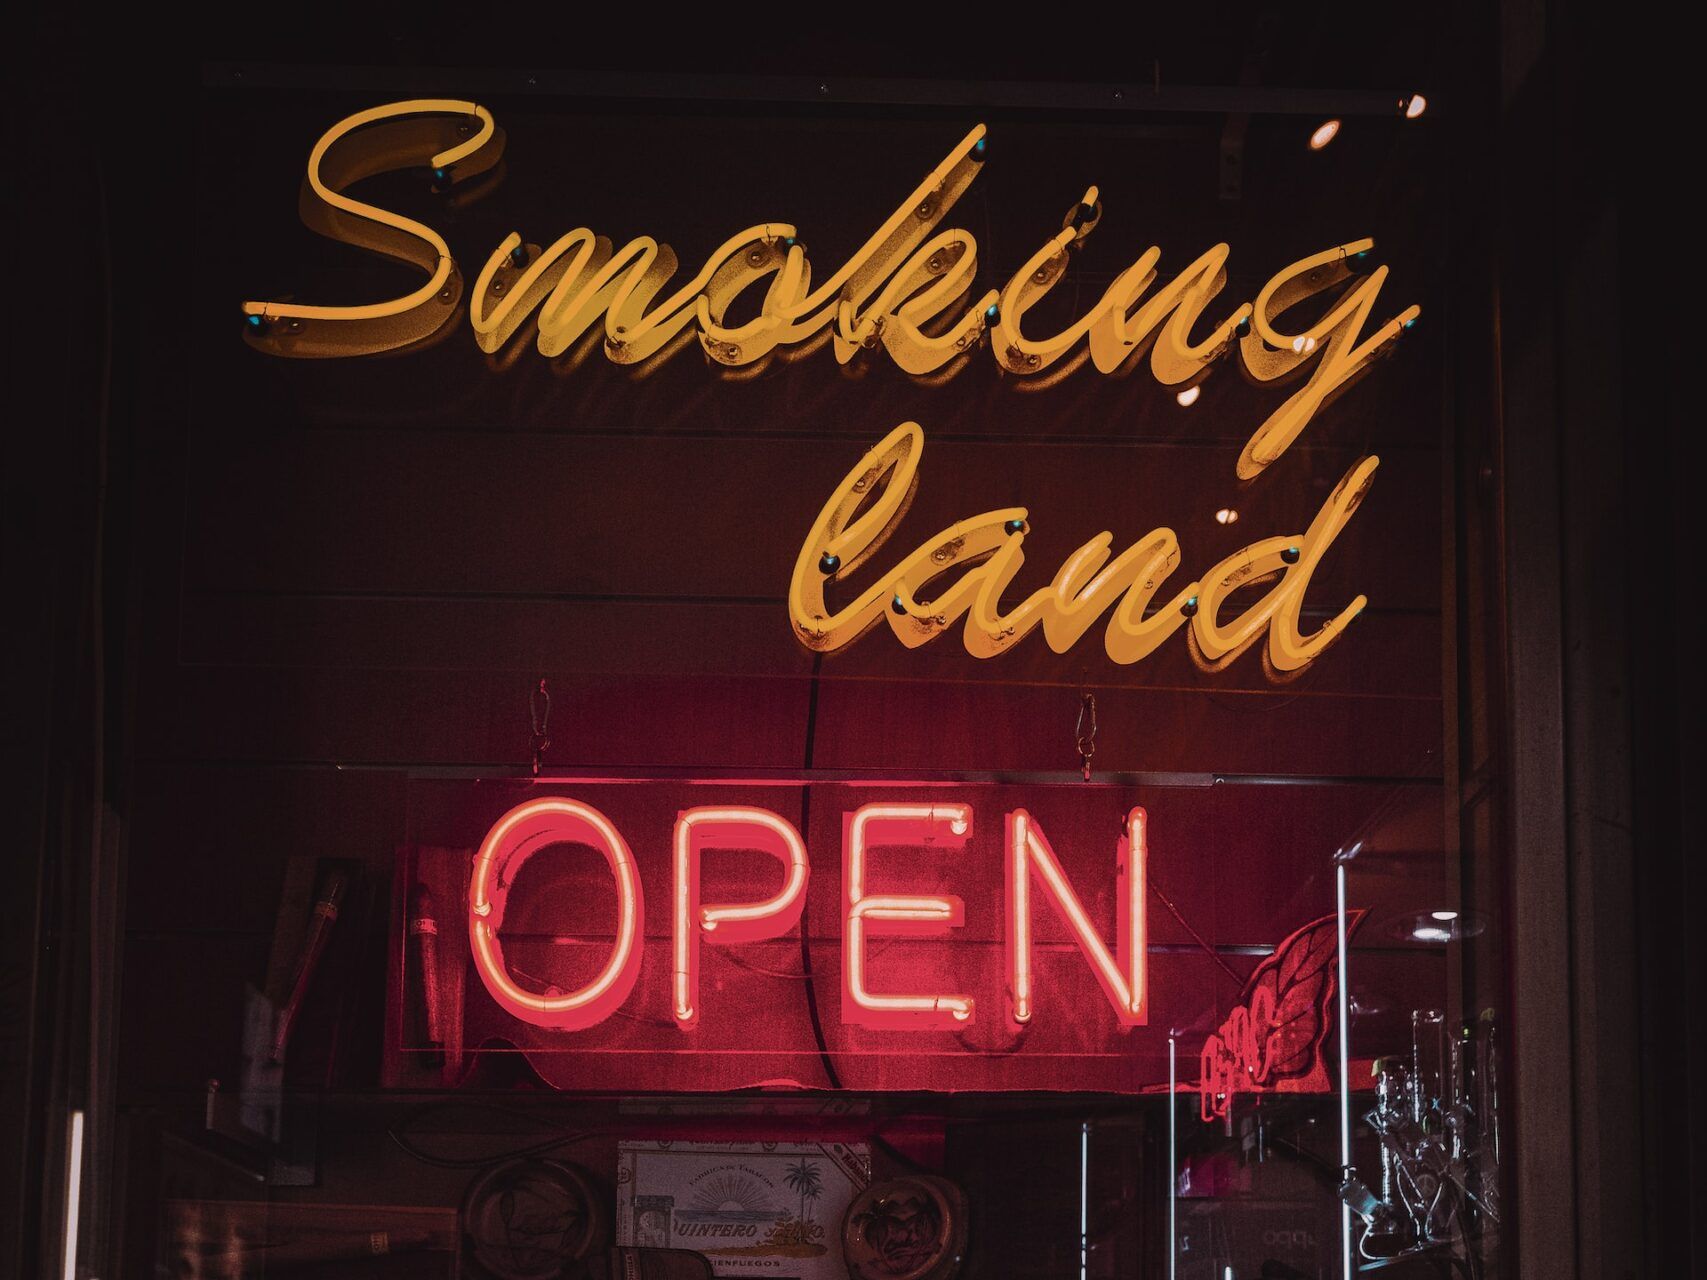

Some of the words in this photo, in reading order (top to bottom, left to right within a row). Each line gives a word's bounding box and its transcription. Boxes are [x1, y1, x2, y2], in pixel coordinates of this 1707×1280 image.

[243, 97, 1421, 479] Smoking
[789, 420, 1379, 673] land
[469, 796, 1147, 1028] OPEN
[673, 1218, 758, 1238] UINTERO
